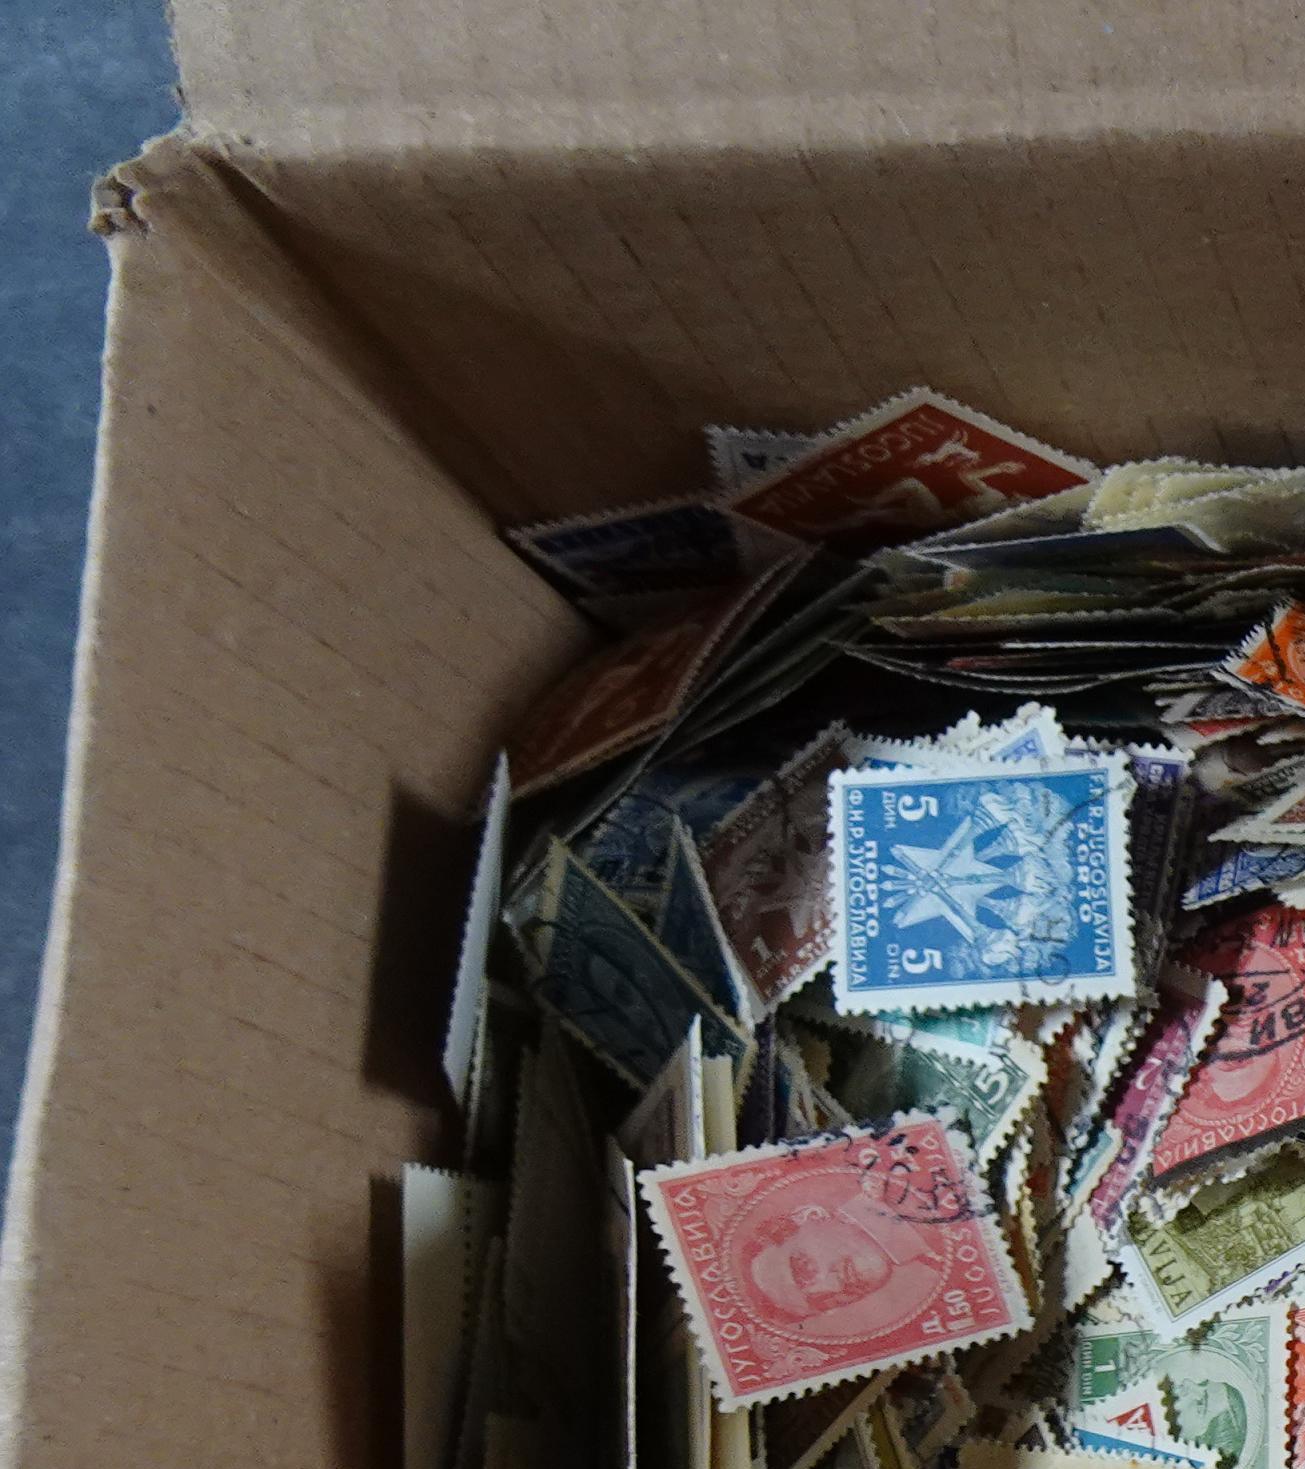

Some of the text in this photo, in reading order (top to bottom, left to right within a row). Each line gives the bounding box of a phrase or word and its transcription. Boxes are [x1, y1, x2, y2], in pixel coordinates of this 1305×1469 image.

[900, 792, 940, 821] 5
[864, 840, 880, 938] ПОРТО
[904, 948, 943, 975] 5
[668, 1179, 763, 1390] ЈУГОСЛАВИЈА
